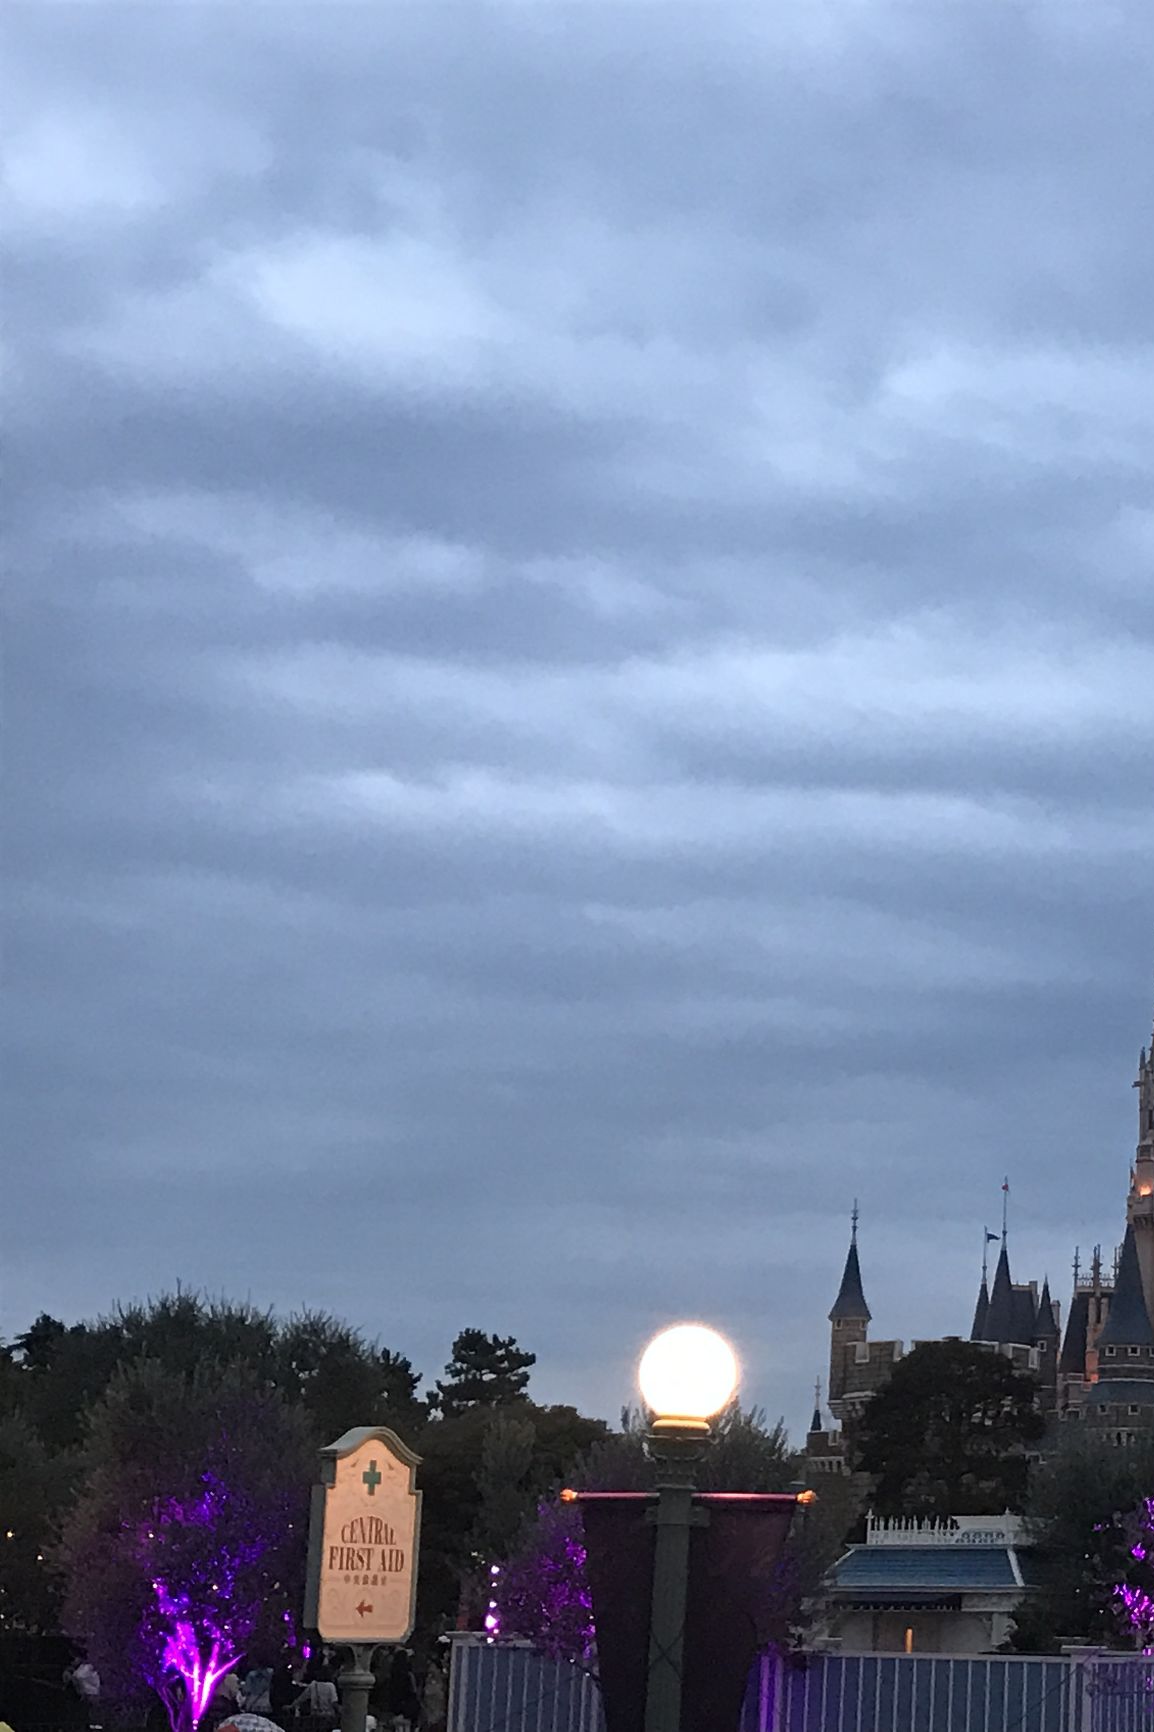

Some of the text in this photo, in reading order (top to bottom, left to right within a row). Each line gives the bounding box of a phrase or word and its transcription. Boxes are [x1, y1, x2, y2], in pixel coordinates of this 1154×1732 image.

[341, 1516, 396, 1545] CENTRAL
[328, 1546, 405, 1572] FIRST AID
